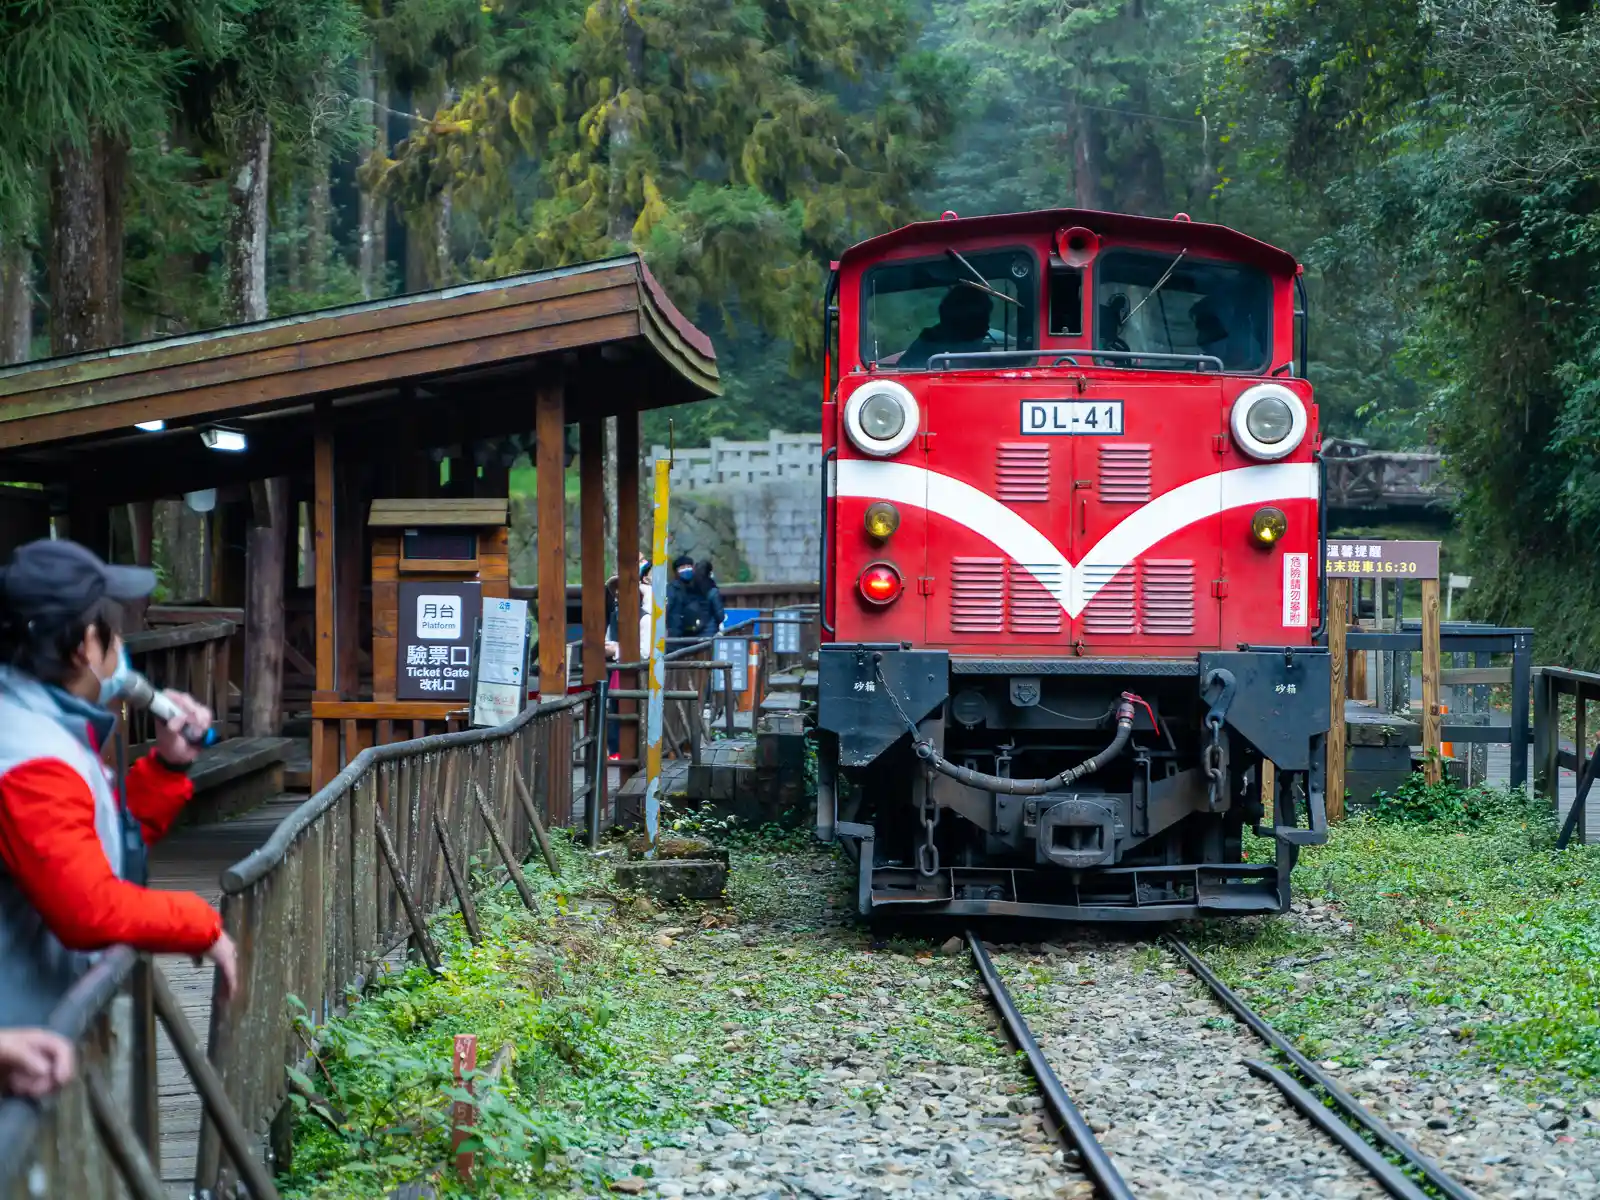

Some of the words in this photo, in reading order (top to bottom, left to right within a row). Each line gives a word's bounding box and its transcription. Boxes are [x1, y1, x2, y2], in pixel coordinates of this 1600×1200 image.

[1031, 406, 1113, 429] DL-41
[423, 603, 455, 619] 月台
[422, 621, 456, 629] Platform
[406, 645, 470, 666] 驗票口
[406, 666, 441, 677] Ticket
[443, 667, 470, 678] Gate
[419, 679, 455, 691] 改札口
